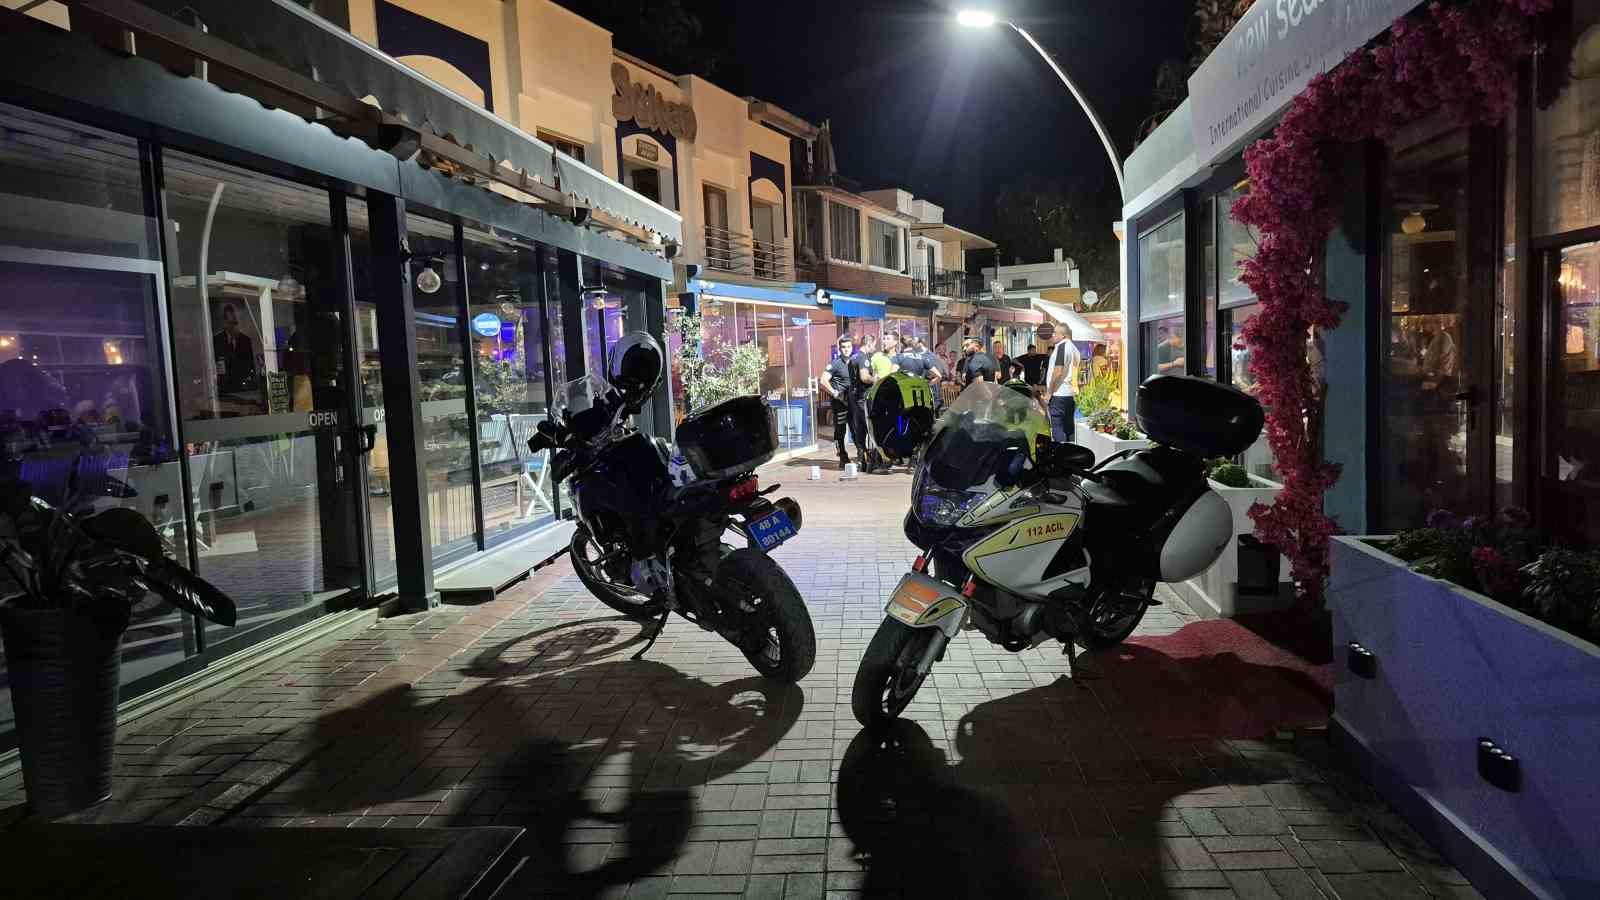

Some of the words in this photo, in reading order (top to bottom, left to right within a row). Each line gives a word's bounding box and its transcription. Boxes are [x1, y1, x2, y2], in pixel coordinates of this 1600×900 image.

[1208, 84, 1262, 145] International
[1263, 58, 1301, 101] Cuisine
[309, 411, 337, 426] OPEN
[1027, 526, 1043, 537] 112
